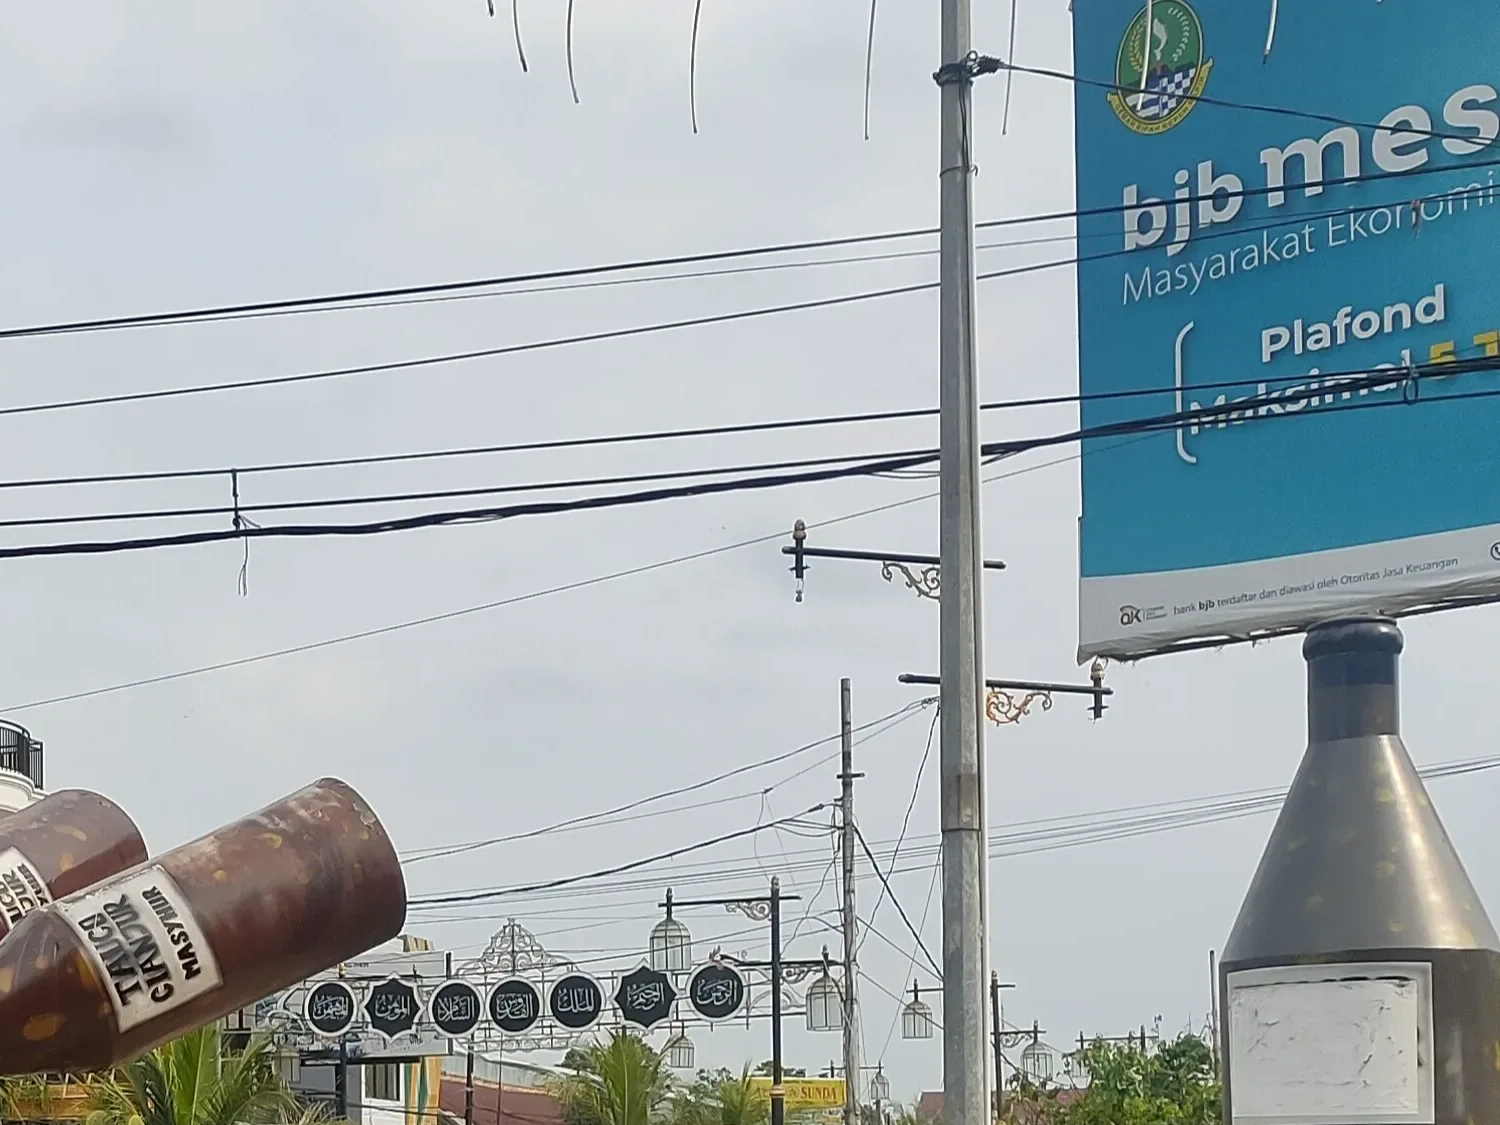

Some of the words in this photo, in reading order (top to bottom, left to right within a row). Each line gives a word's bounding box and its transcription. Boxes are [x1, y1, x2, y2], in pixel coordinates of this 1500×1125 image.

[1122, 160, 1244, 256] bjb
[1260, 84, 1500, 208] mes
[1122, 224, 1315, 305] Masyarakat
[1327, 170, 1496, 247] Ekonomi
[1261, 283, 1445, 363] Plafond
[1173, 604, 1197, 616] bank
[1198, 600, 1215, 612] bjb
[1217, 591, 1257, 607] terdaftar
[1258, 588, 1278, 600] dan
[1278, 581, 1315, 597] diawasi
[1316, 576, 1338, 590] oleh
[1340, 570, 1381, 586] Otoritas
[1382, 566, 1404, 580] Jasa
[1405, 556, 1459, 576] Keuangan
[77, 912, 144, 1008] TAUCO
[102, 893, 176, 1004] CIANJUR
[140, 884, 203, 981] MASYHUR
[801, 1086, 837, 1100] SUNDA
